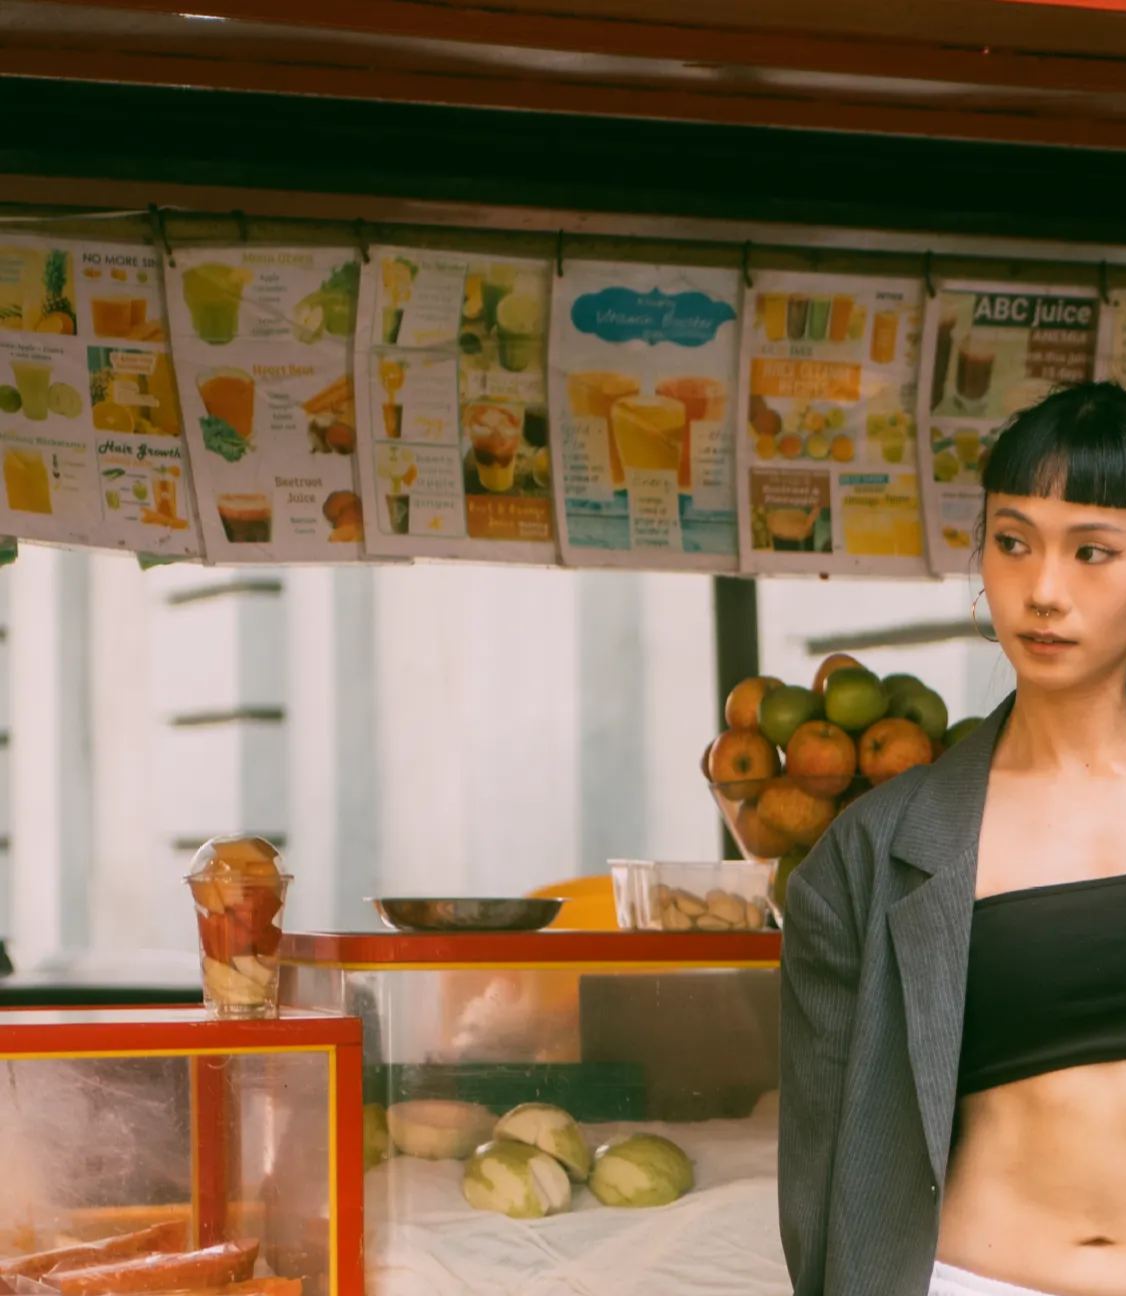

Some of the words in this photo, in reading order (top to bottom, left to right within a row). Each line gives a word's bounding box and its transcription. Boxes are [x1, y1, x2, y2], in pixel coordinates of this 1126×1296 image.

[83, 253, 102, 265] NO
[105, 255, 139, 268] MORE
[974, 297, 1029, 321] ABC
[1031, 299, 1092, 328] juice
[98, 440, 133, 456] Hair
[138, 443, 182, 460] Growth
